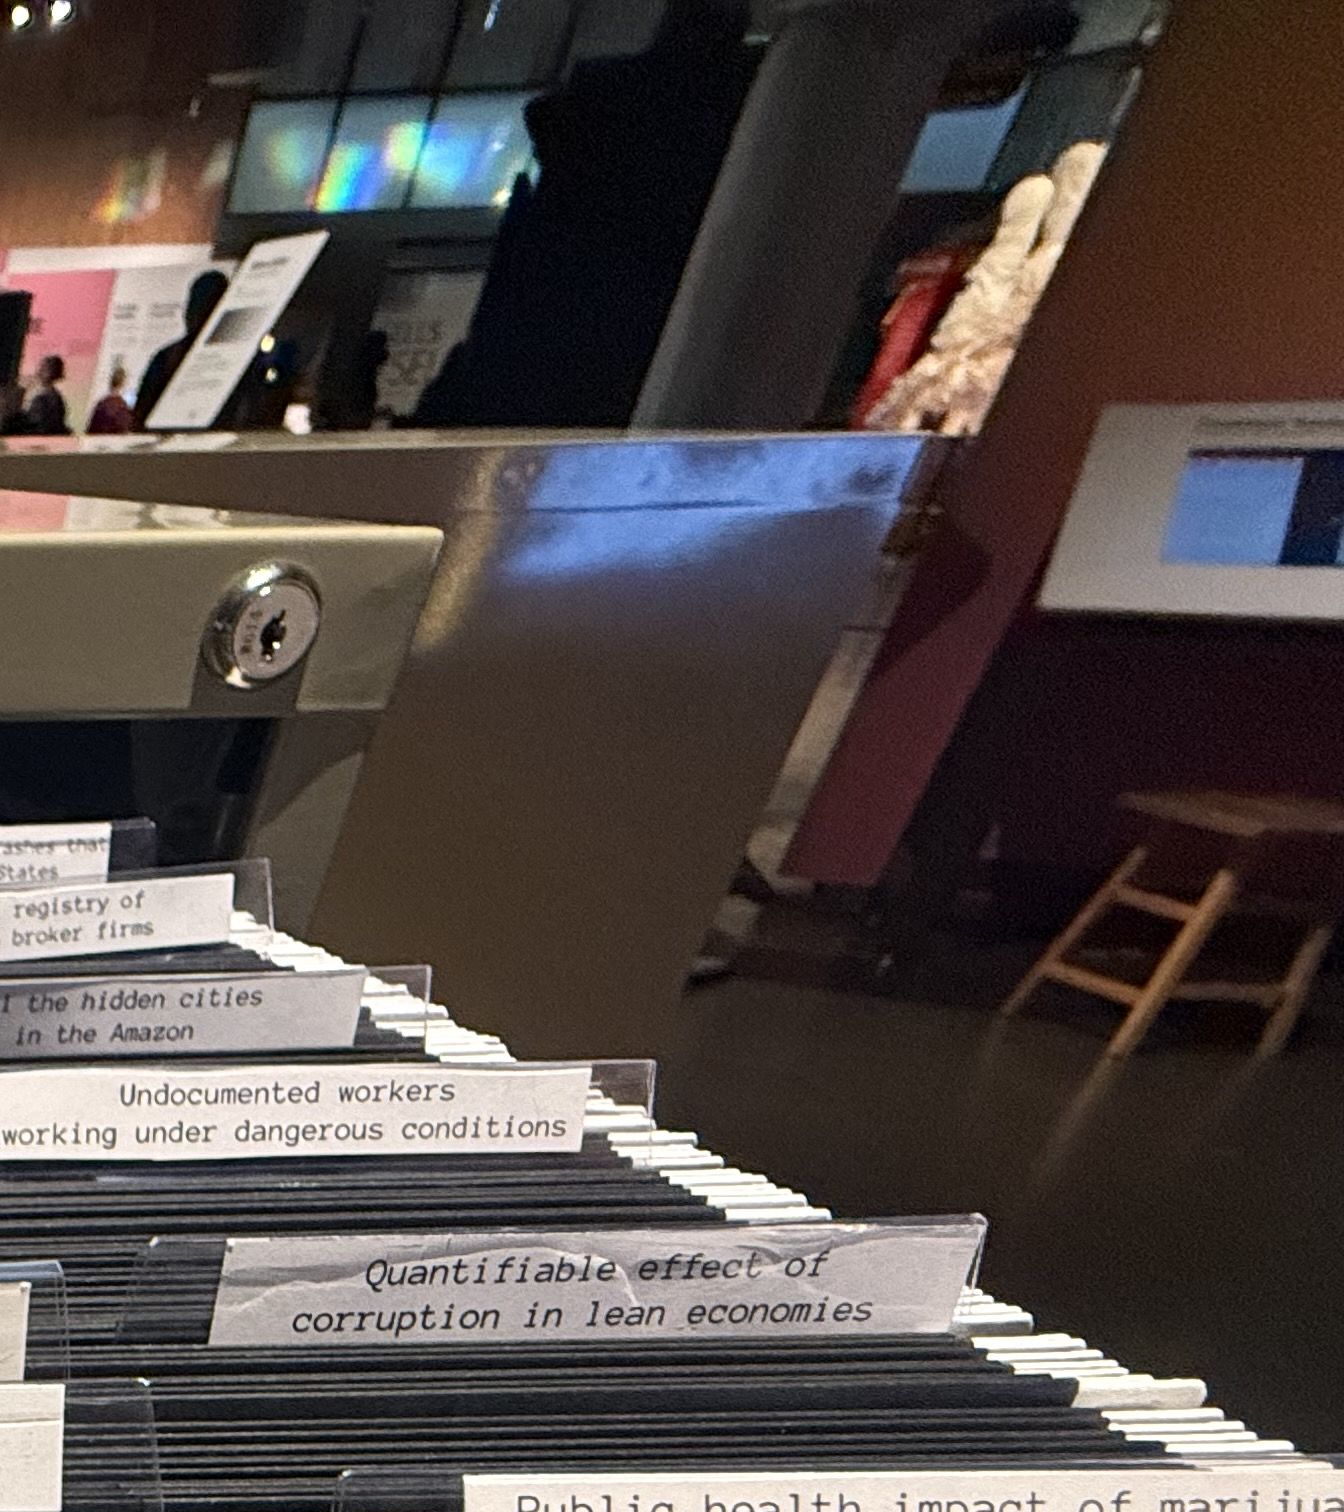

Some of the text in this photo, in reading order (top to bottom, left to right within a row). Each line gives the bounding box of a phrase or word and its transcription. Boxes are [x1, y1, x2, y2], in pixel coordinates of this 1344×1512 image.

[14, 896, 109, 920] registry
[120, 890, 144, 909] of
[12, 926, 82, 946] broker
[99, 920, 153, 940] firms
[28, 994, 67, 1013] the
[81, 990, 165, 1011] hidden
[180, 987, 262, 1008] cities
[16, 1022, 194, 1046] in the Amazon
[120, 1080, 455, 1106] Undocumented workers
[2, 1116, 566, 1150] working under dangerous conditions
[366, 1248, 830, 1292] Quantifiable effect of
[292, 1297, 873, 1338] corruption in lean economies
